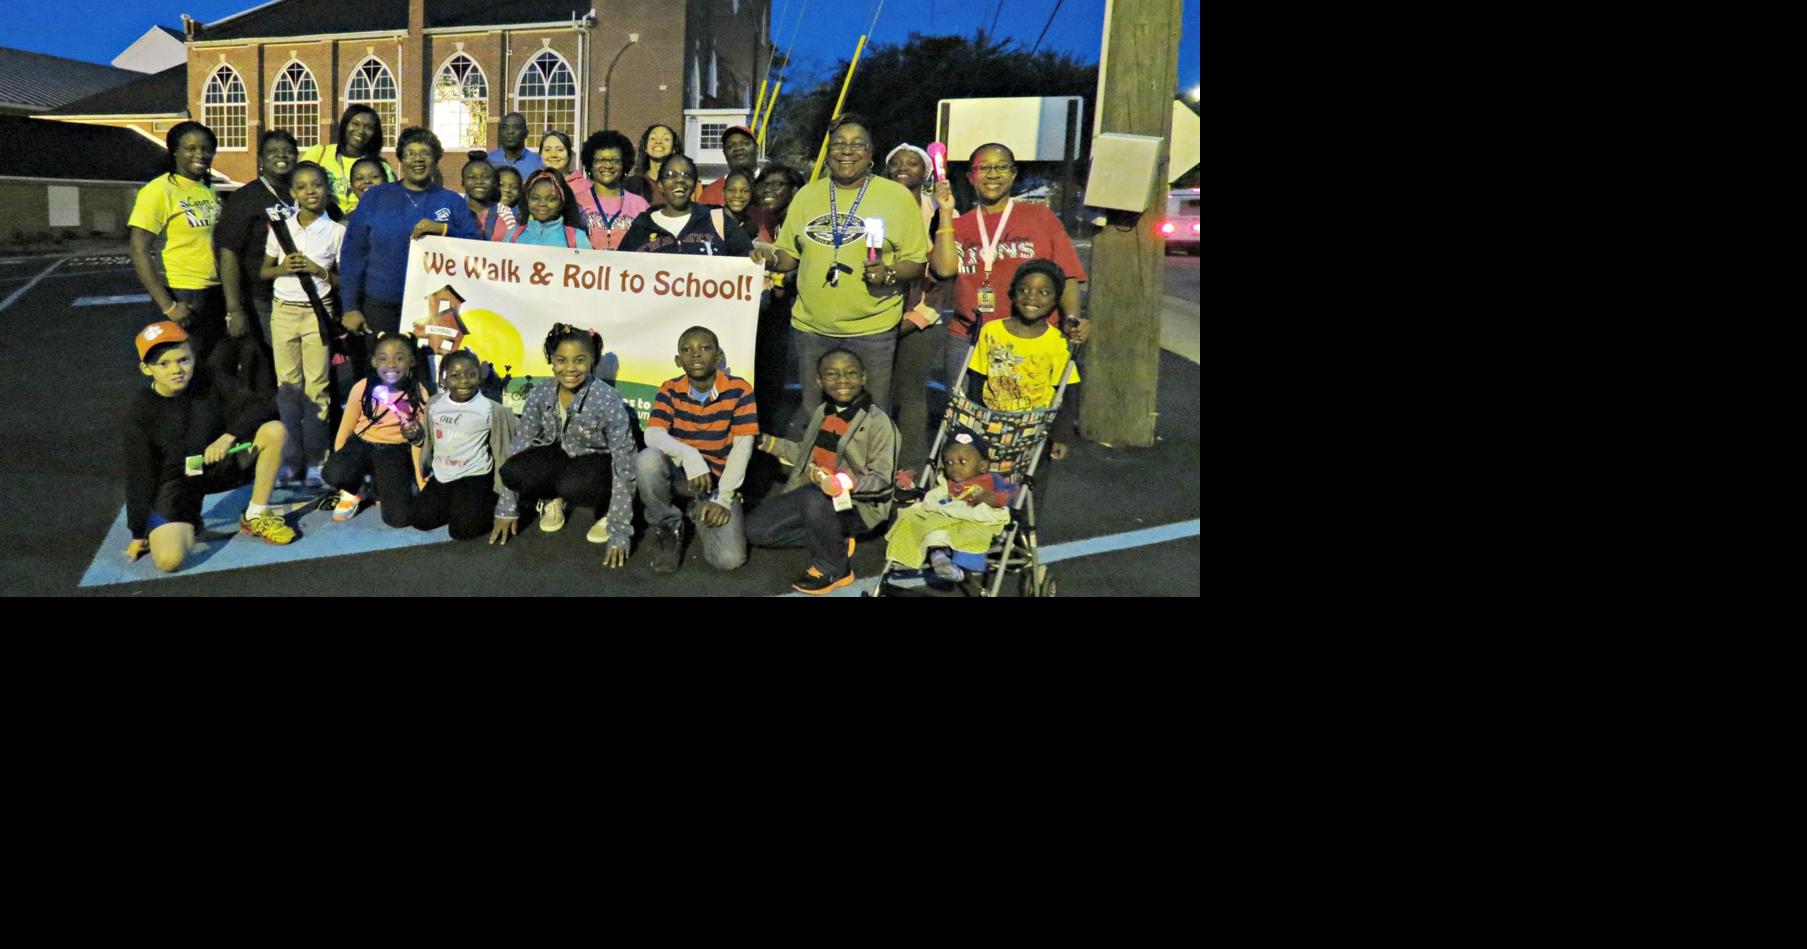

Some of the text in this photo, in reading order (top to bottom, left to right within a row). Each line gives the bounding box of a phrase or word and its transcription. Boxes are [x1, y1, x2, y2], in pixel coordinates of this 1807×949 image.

[423, 251, 753, 302] We Walk & Roll to School!
[637, 398, 652, 410] to
